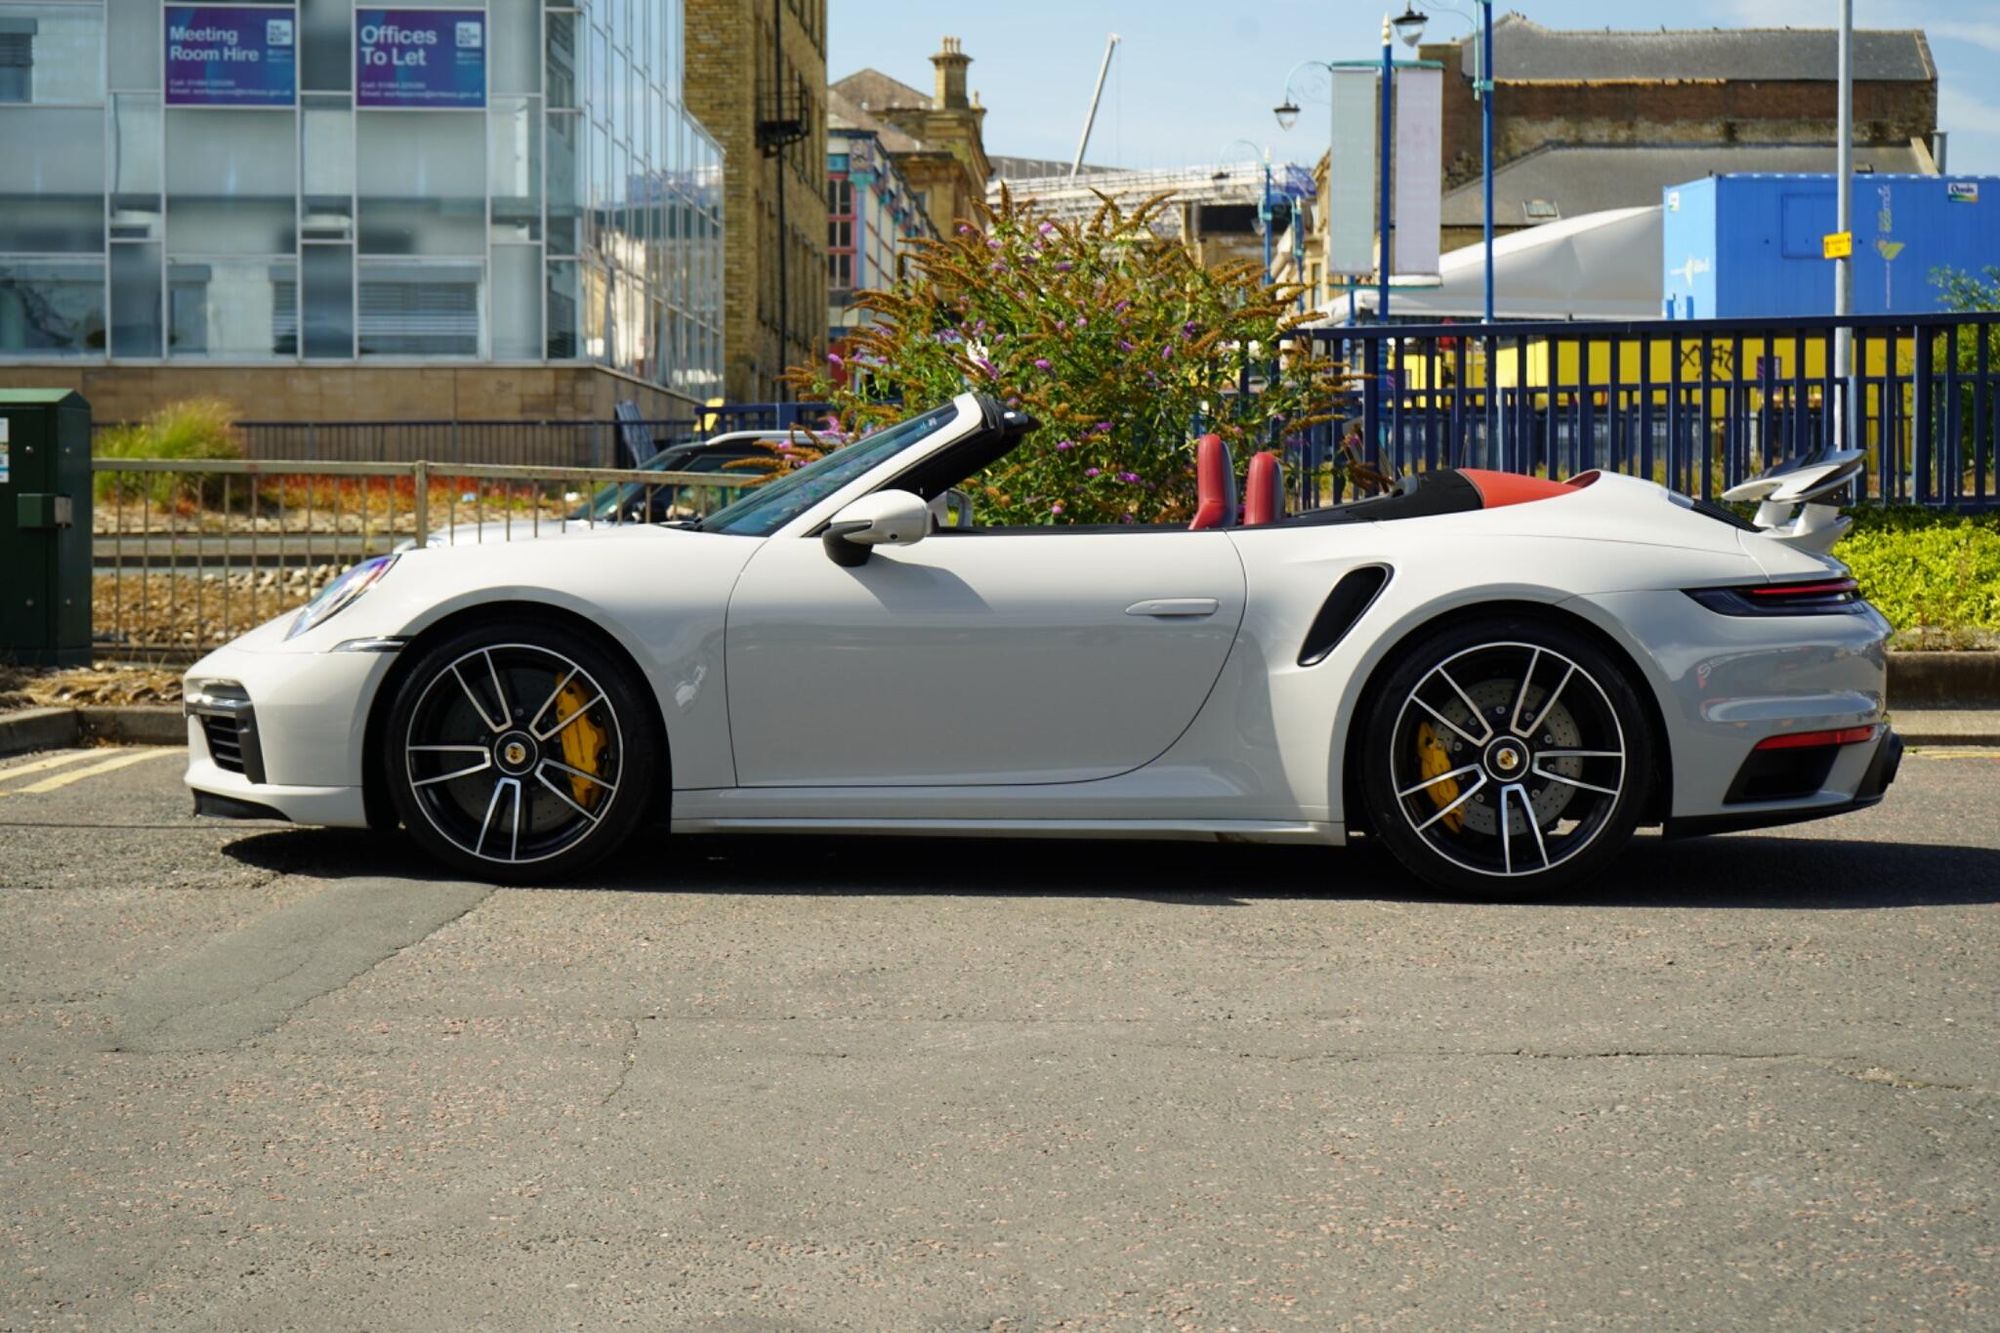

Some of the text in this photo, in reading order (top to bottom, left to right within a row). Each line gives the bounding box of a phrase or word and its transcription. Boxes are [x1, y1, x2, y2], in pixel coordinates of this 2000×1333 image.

[170, 26, 238, 45] Meeting
[361, 25, 437, 45] Offices
[170, 46, 219, 61] Room
[223, 47, 259, 62] Hire
[361, 47, 427, 66] To Let
